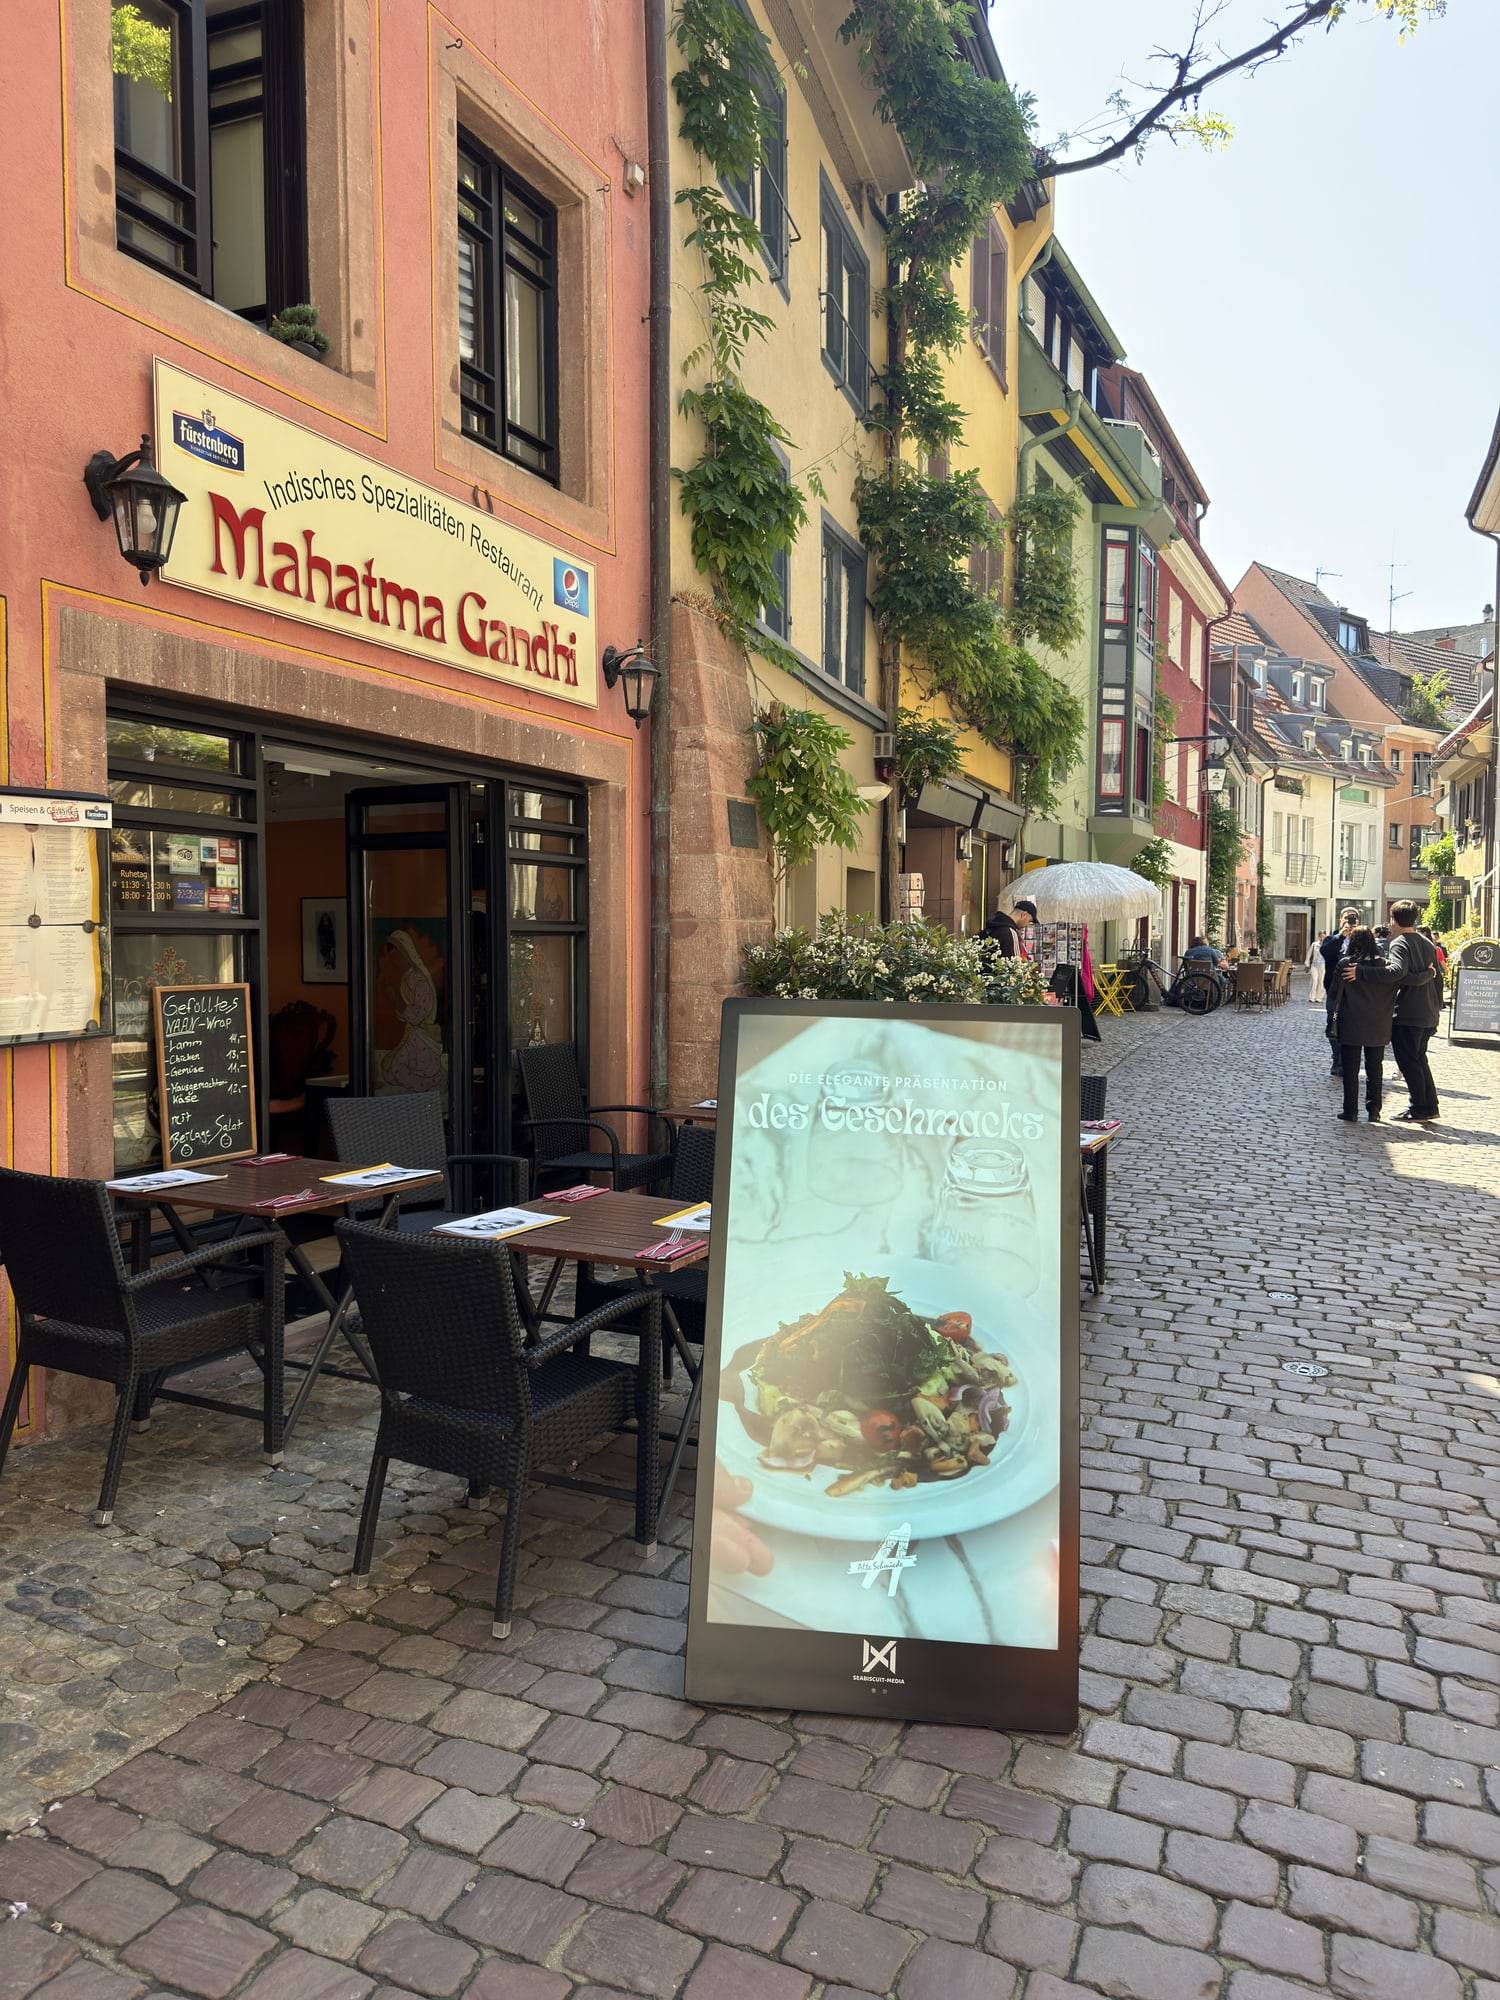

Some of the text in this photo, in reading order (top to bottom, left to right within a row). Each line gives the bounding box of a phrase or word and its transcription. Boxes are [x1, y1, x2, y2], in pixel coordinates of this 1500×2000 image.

[180, 420, 238, 465] Fürstenberg
[264, 469, 545, 613] Indisches Spezialitäten Restaurant
[208, 491, 579, 687] Mahatma Gandhi
[9, 804, 38, 815] Speisen
[40, 806, 45, 814] &
[120, 870, 148, 880] Ruhetag
[121, 880, 140, 888] 11:30
[146, 881, 165, 889] 1:30
[121, 892, 140, 900] 18:00
[146, 892, 165, 900] 2:00
[166, 892, 171, 900] h
[163, 994, 239, 1018] Gefülltes
[788, 1072, 1008, 1091] DIE ELEGANTE PRÄSENTATION
[172, 1094, 200, 1105] Käse
[172, 1111, 192, 1125] mit
[748, 1093, 1045, 1140] des Geschmacks
[169, 1129, 212, 1153] Beilage
[852, 1674, 905, 1684] SEABISCUIT-MEDIA
